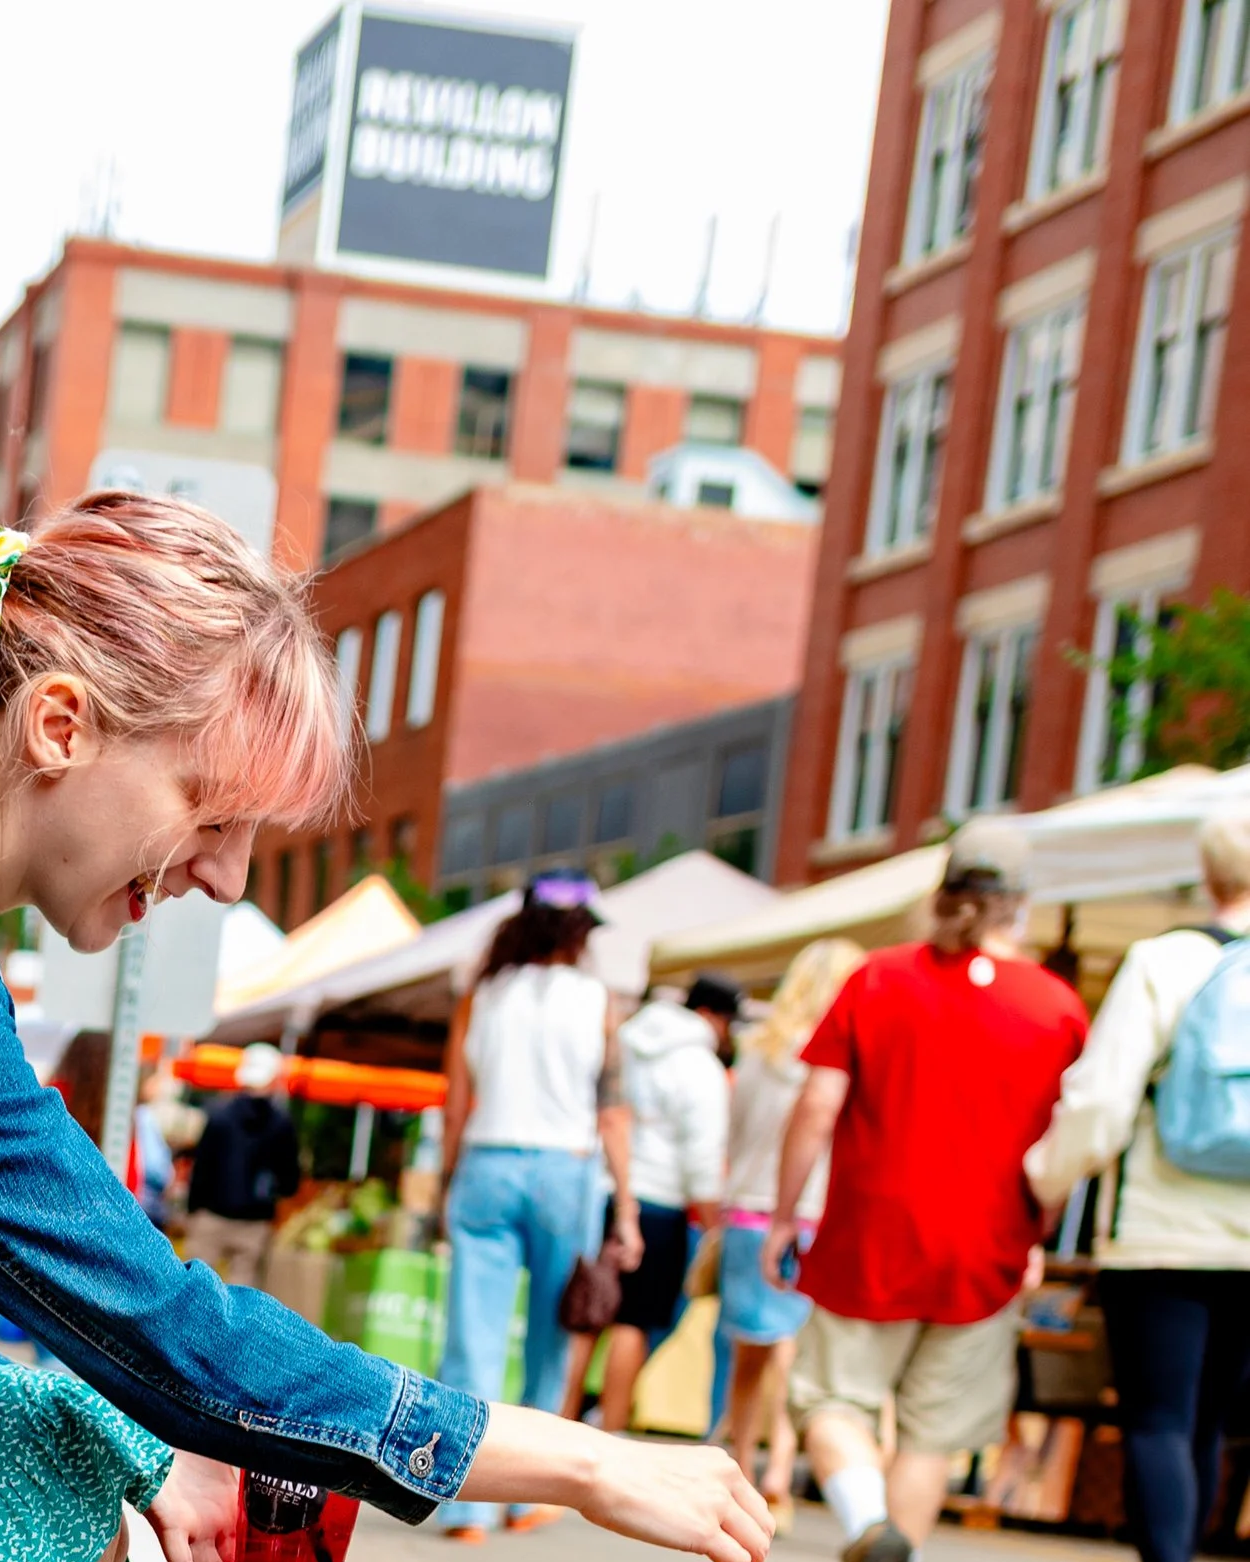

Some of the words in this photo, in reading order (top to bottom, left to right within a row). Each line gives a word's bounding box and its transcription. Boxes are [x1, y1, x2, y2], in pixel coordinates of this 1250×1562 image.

[358, 68, 562, 144] REVILLON
[350, 122, 554, 201] BUILDING
[253, 1483, 302, 1506] COFFEE
